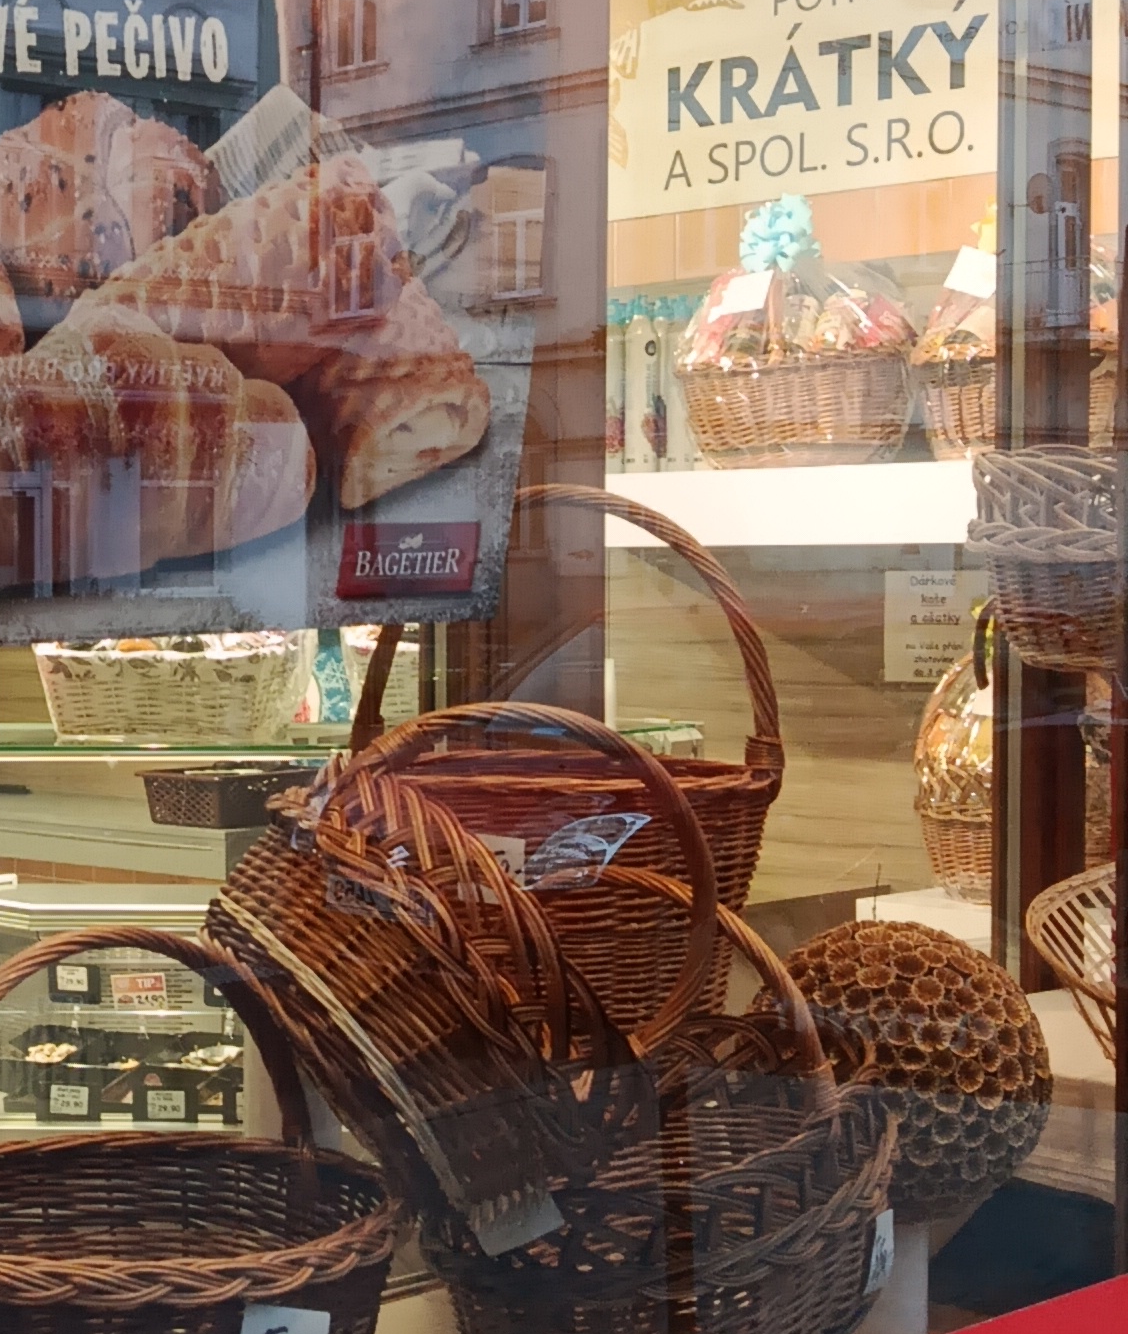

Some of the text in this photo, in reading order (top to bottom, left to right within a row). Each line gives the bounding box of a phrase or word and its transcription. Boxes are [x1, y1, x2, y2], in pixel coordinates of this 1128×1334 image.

[664, 109, 974, 191] A SPOL. S.R.O.
[355, 548, 460, 577] BAGETIER
